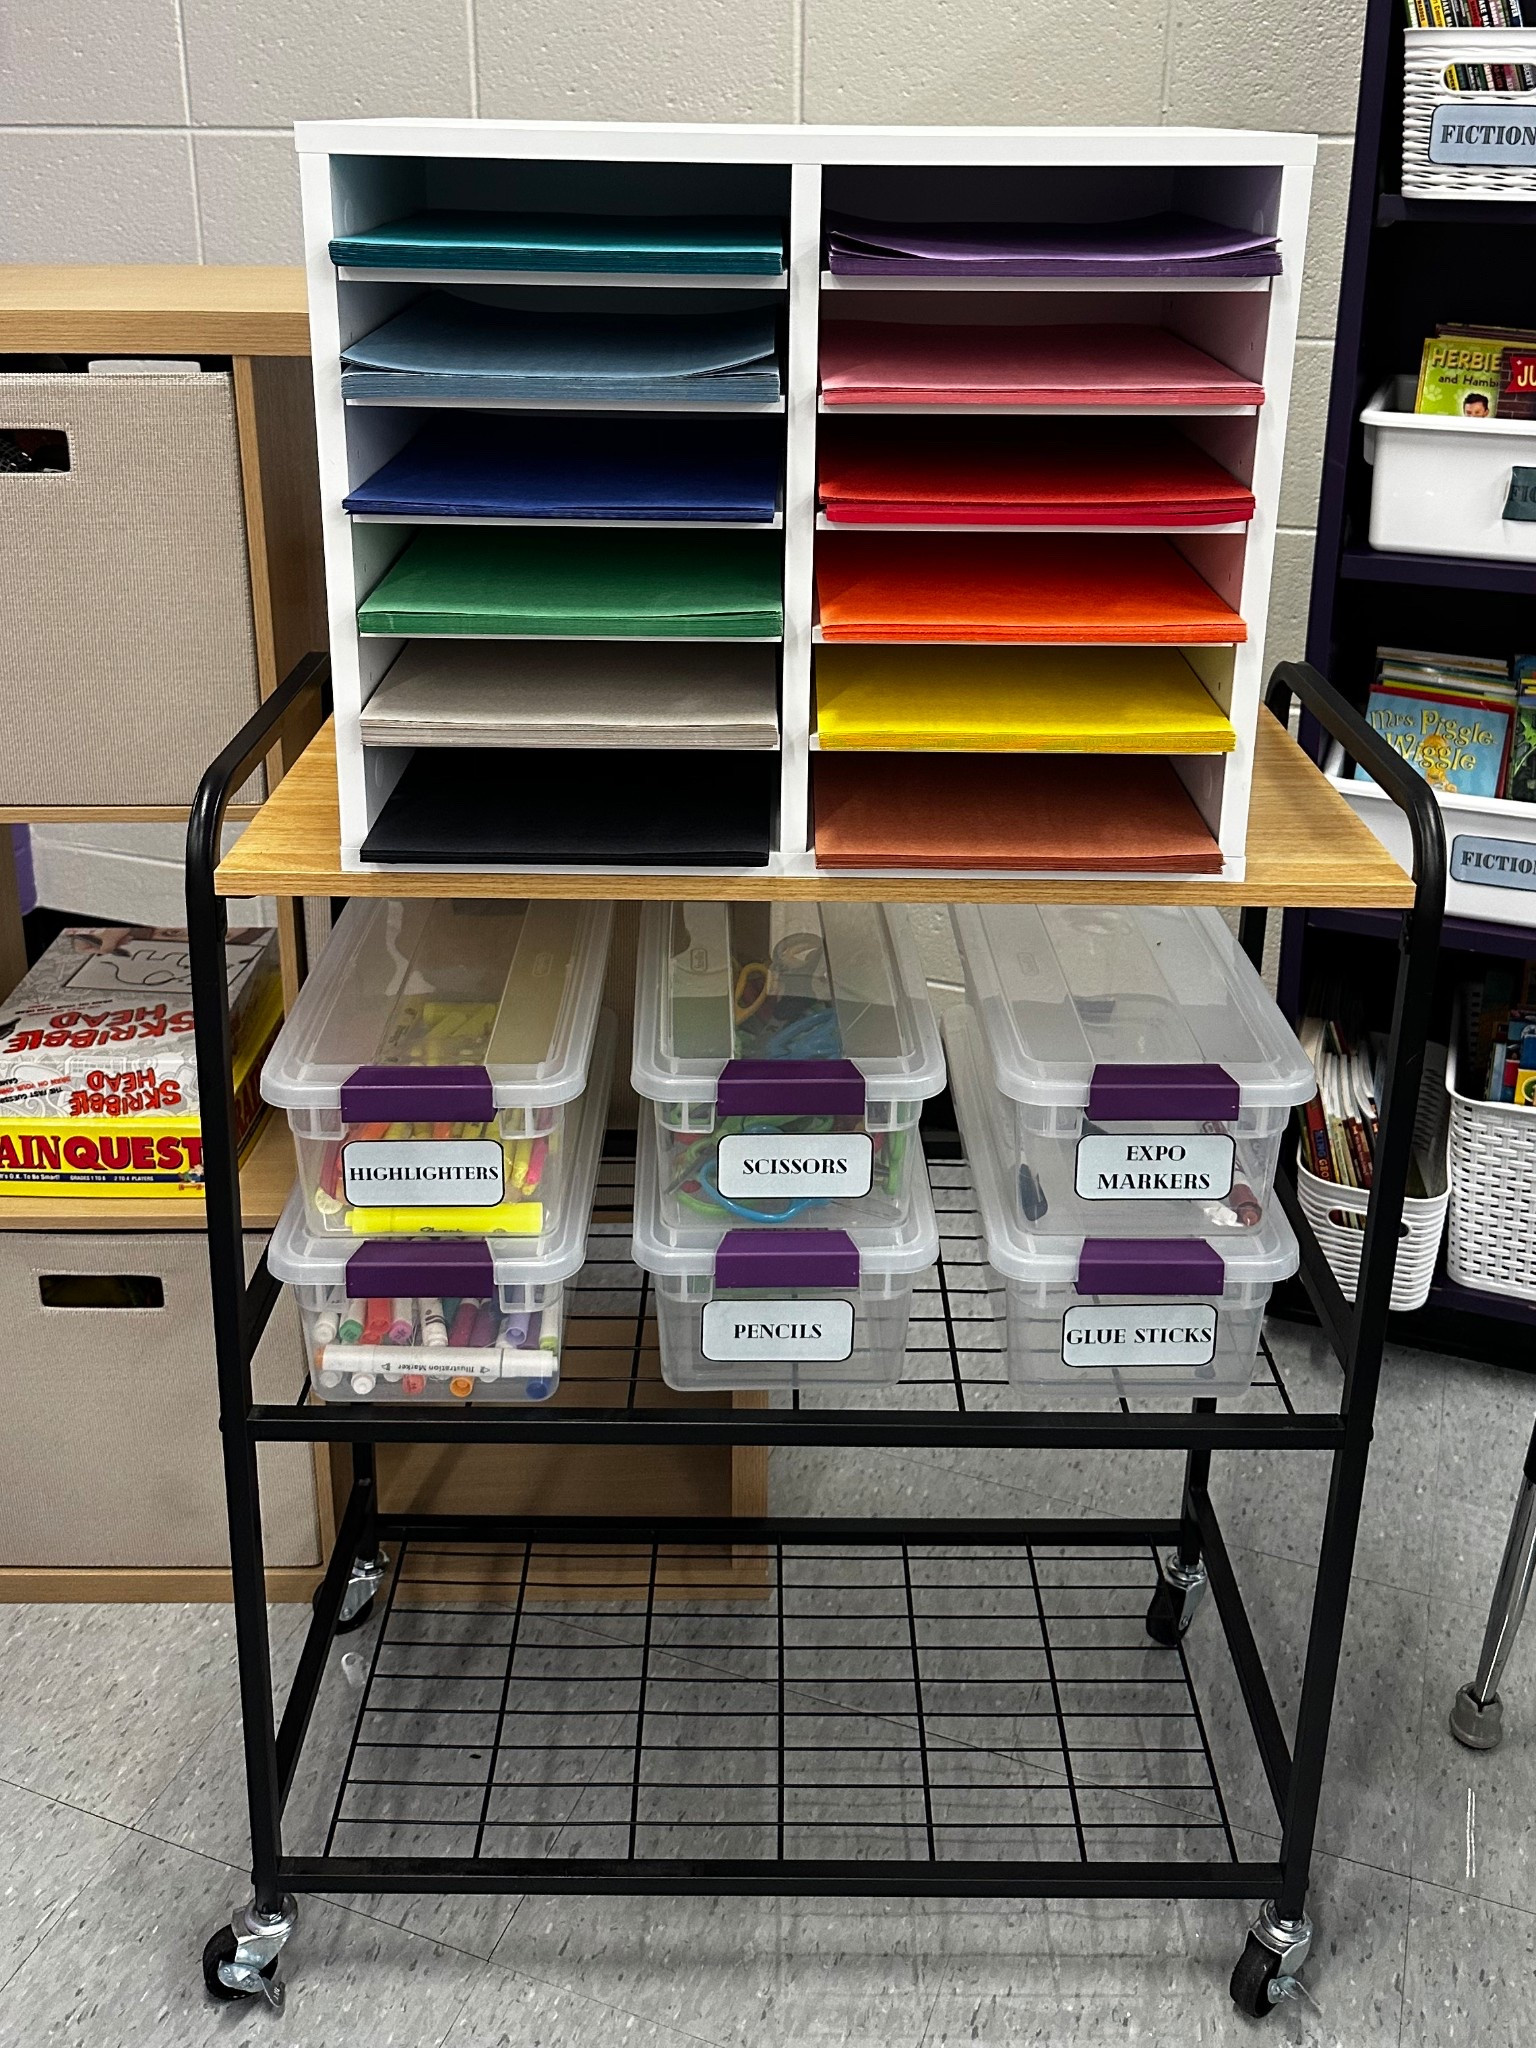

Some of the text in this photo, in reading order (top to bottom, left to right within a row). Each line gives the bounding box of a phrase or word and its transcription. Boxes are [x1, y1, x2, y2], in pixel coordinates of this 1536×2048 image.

[1440, 125, 1536, 146] FICTION
[1432, 348, 1502, 373] HERBIE
[1438, 374, 1458, 384] and
[1369, 709, 1494, 747] Mrs. Piggle
[1384, 731, 1477, 771] Wiggle
[1461, 850, 1536, 875] FICTIO
[49, 1003, 167, 1029] HEAD
[3, 1010, 194, 1053] SKRIBBLE
[87, 1067, 156, 1093] HEAD
[69, 1079, 182, 1117] SKRIBBLE
[1126, 1145, 1186, 1162] EXPO
[349, 1166, 499, 1181] HIGHLIGHTERS
[742, 1158, 848, 1175] SCISSORS
[1318, 1158, 1331, 1180] GEO
[1097, 1172, 1210, 1190] MARKERS
[733, 1323, 822, 1339] PENCILS
[1066, 1327, 1212, 1344] GLUE STICKS
[397, 1363, 474, 1373] Illustration Marker
